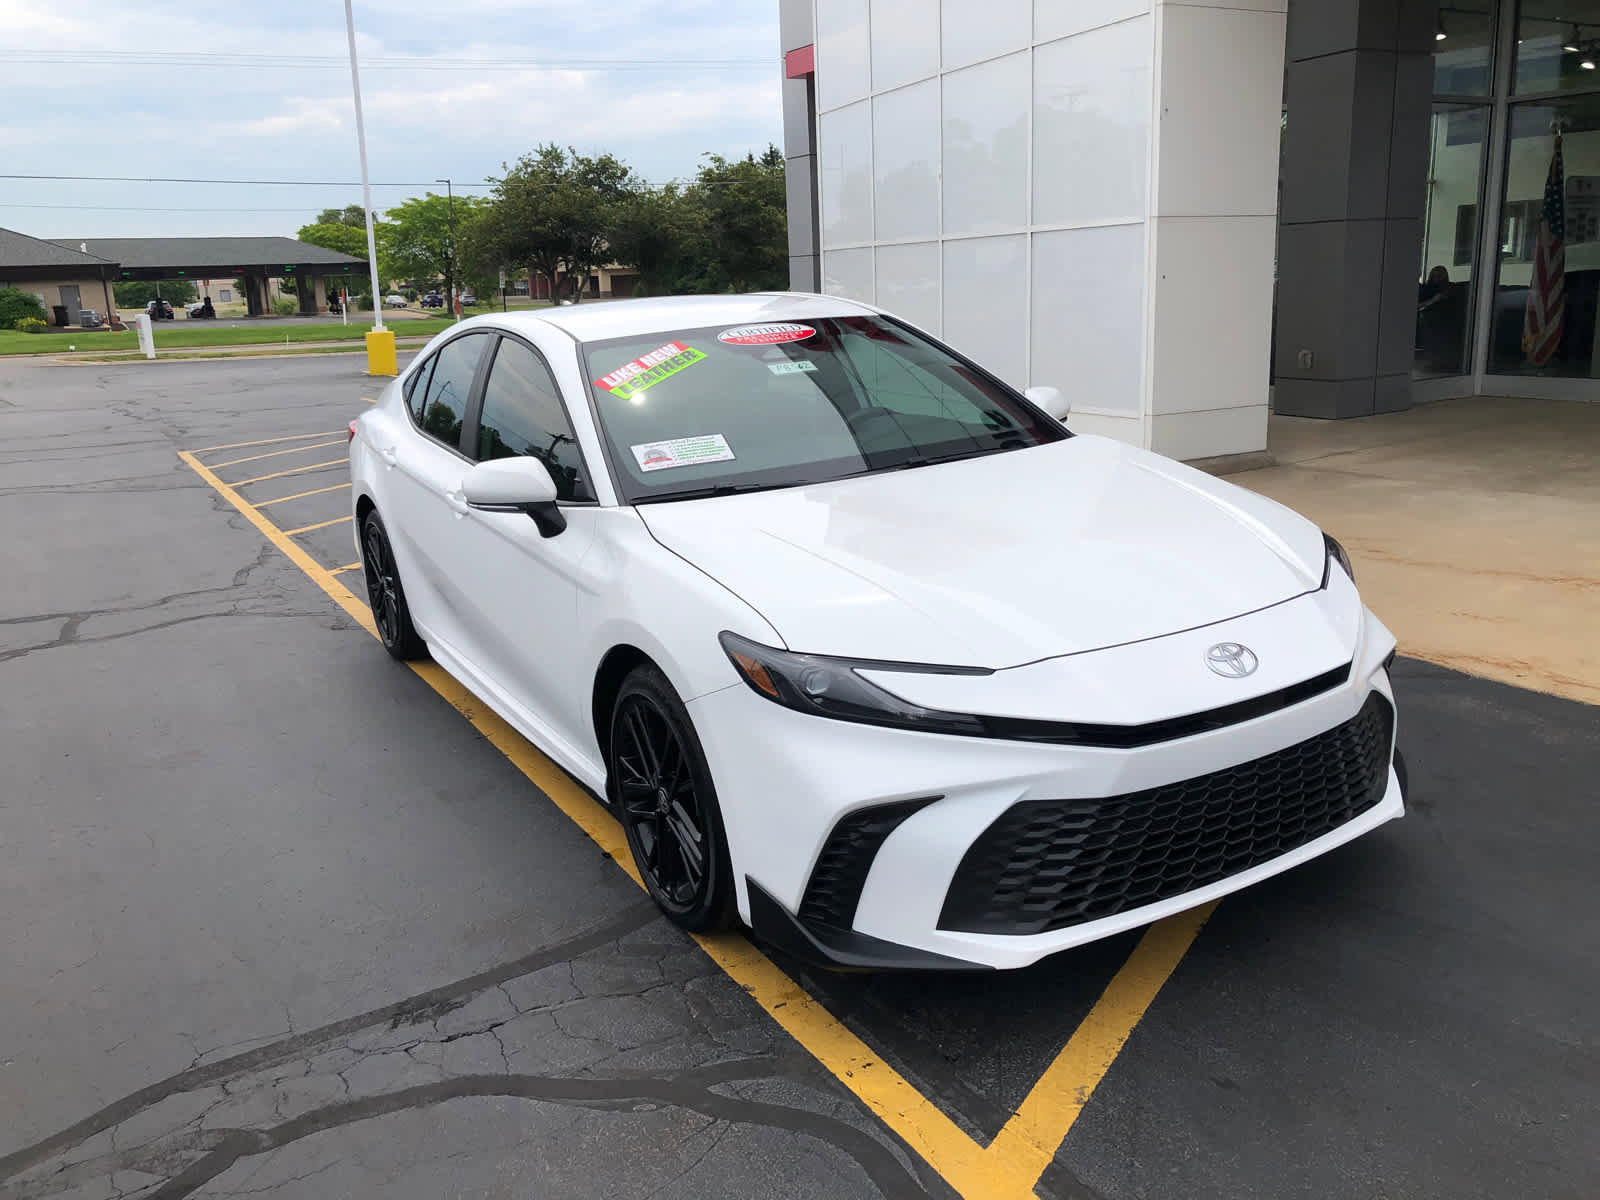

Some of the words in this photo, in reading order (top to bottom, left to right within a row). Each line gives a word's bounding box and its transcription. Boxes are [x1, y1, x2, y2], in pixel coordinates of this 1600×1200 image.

[601, 361, 646, 388] LIKE
[639, 343, 681, 368] NEW
[618, 349, 698, 394] LEATHER
